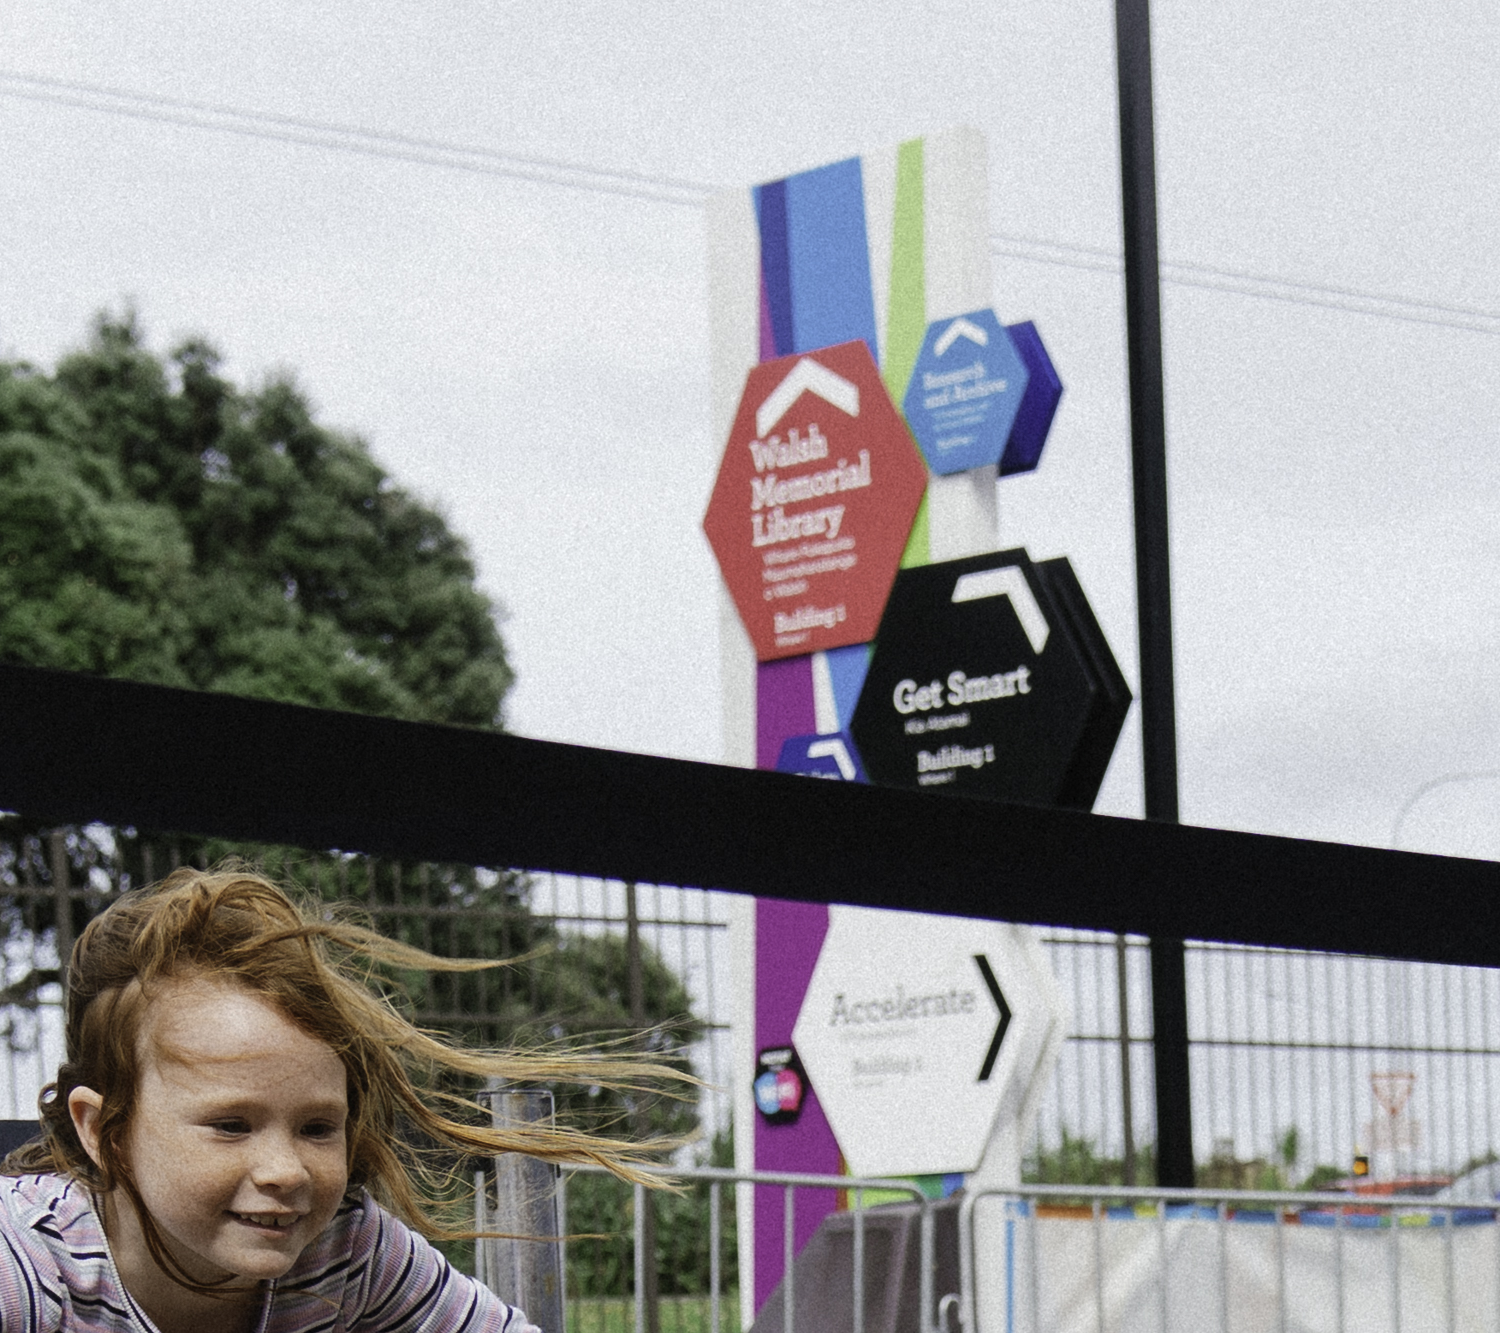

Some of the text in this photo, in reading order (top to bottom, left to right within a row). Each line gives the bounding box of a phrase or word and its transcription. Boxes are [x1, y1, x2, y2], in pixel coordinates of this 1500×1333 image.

[749, 423, 829, 472] Walsh
[750, 449, 872, 511] Memorial
[752, 504, 845, 547] Library
[774, 605, 835, 634] Building
[893, 664, 1032, 715] Get Smart
[917, 745, 983, 772] Building
[829, 984, 977, 1027] Accelerate
